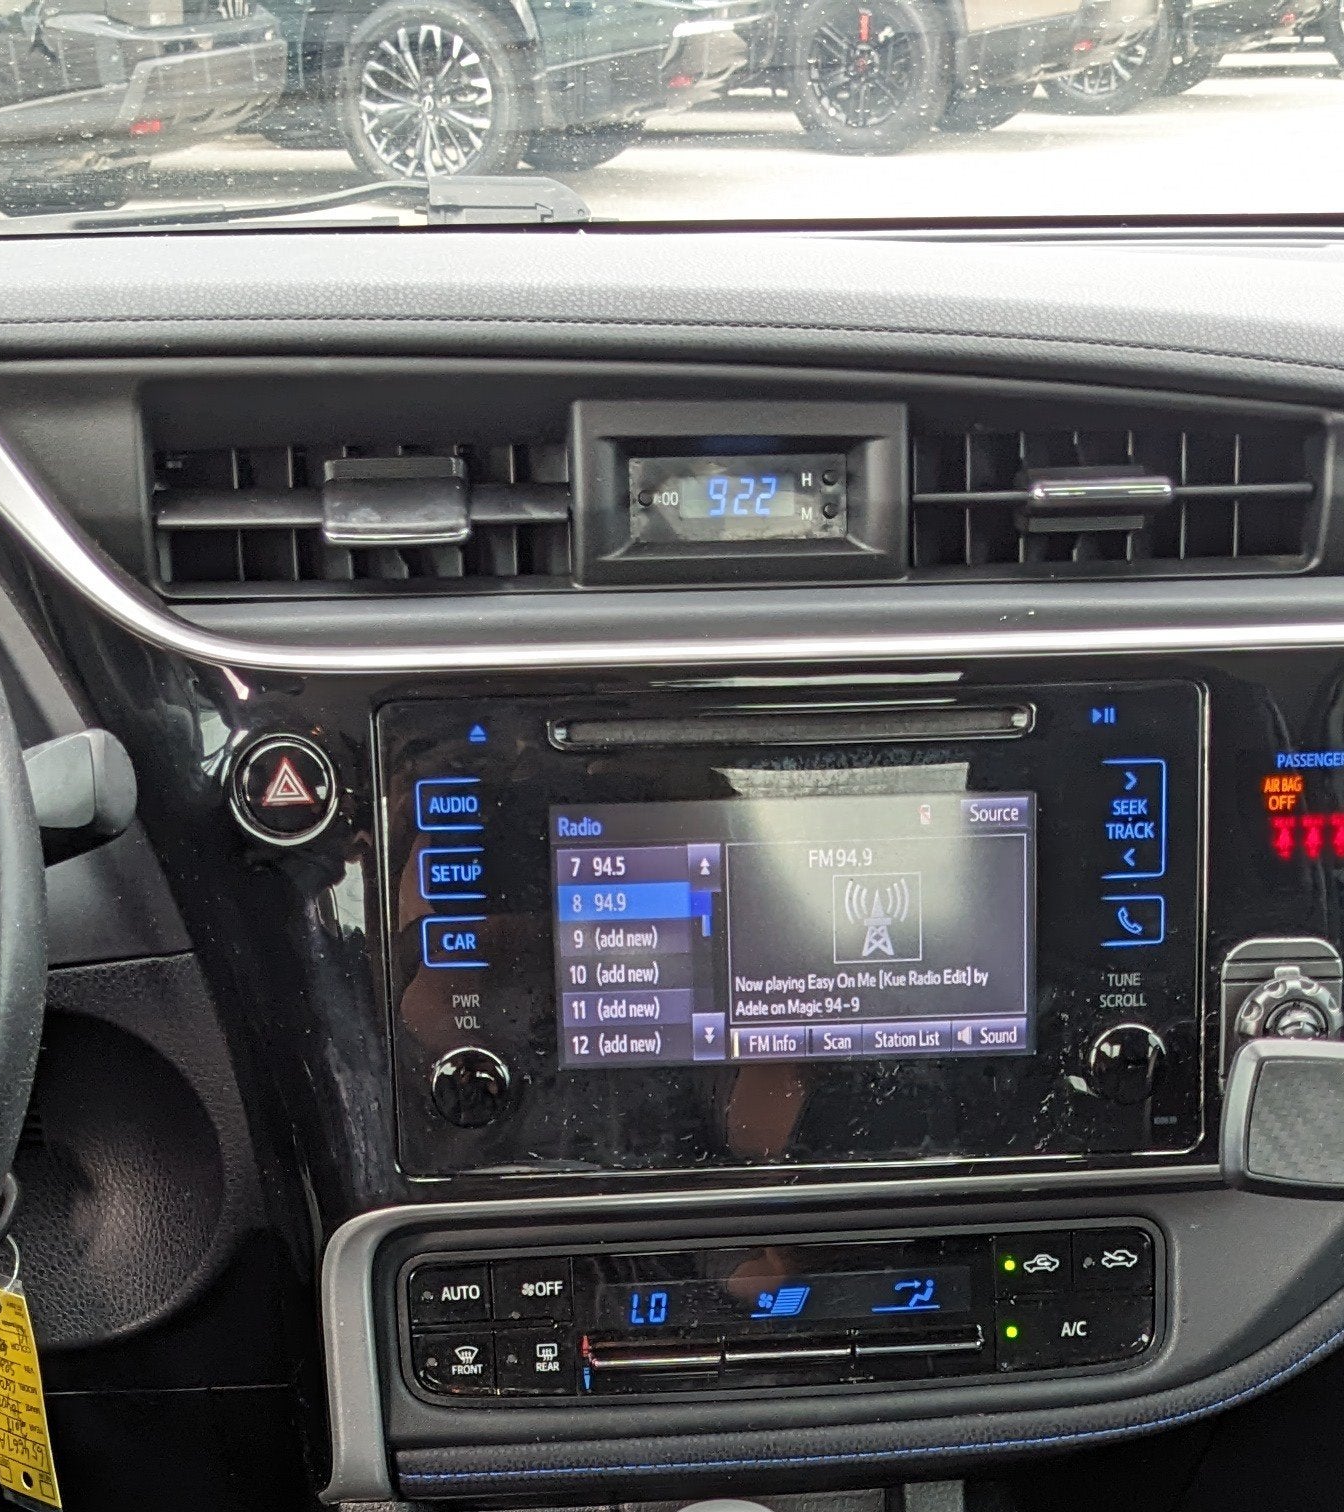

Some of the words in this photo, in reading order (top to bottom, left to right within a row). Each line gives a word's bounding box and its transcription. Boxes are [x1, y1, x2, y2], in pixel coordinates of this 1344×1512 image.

[801, 473, 812, 487] H
[801, 507, 812, 521] M
[1264, 778, 1280, 793] AIR
[1281, 776, 1303, 792] BAG
[429, 797, 478, 814] AUDIO
[1113, 800, 1147, 816] SEEK
[1268, 795, 1296, 811] OFF
[969, 803, 1019, 822] Source
[558, 816, 602, 836] Radio
[1106, 823, 1155, 840] TRACK
[570, 857, 581, 877] 7
[592, 856, 626, 877] 94.5
[808, 849, 833, 868] FM
[835, 848, 873, 867] 94.9
[431, 864, 482, 883] SETUP
[572, 894, 582, 913] 8
[594, 893, 627, 912] 94.9
[442, 933, 476, 951] CAR
[573, 929, 584, 949] 9
[595, 927, 624, 950] (add
[627, 925, 658, 949] new)
[569, 965, 587, 985] 10
[596, 962, 625, 986] (add
[628, 961, 659, 985] new)
[735, 976, 764, 992] Now
[765, 975, 806, 994] playing
[807, 973, 835, 992] Easy
[837, 972, 856, 989] On
[857, 972, 877, 988] Me
[908, 969, 942, 986] Radio
[943, 966, 972, 987] Edit]
[974, 968, 989, 987] by
[1108, 973, 1141, 987] TUNE
[452, 994, 480, 1008] PWR
[572, 1000, 586, 1020] 11
[597, 997, 626, 1021] (add
[629, 996, 660, 1019] new)
[735, 1000, 769, 1017] Adele
[770, 1003, 786, 1015] on
[787, 998, 823, 1017] Magic
[824, 996, 860, 1013] 94-9
[1099, 993, 1147, 1008] SCROLL
[454, 1016, 481, 1030] VOL
[572, 1035, 590, 1055] 12
[598, 1032, 628, 1056] (add
[631, 1031, 662, 1055] new)
[749, 1035, 770, 1053] FM
[772, 1034, 796, 1052] Info
[823, 1032, 852, 1050] Scan
[874, 1030, 916, 1049] Station
[919, 1029, 940, 1047] List
[980, 1026, 1017, 1044] Sound
[441, 1284, 480, 1302] AUTO
[534, 1281, 563, 1297] OFF
[630, 1292, 667, 1324] LO
[1060, 1320, 1087, 1337] A/C
[452, 1364, 483, 1375] FRONT
[536, 1362, 560, 1372] REAR
